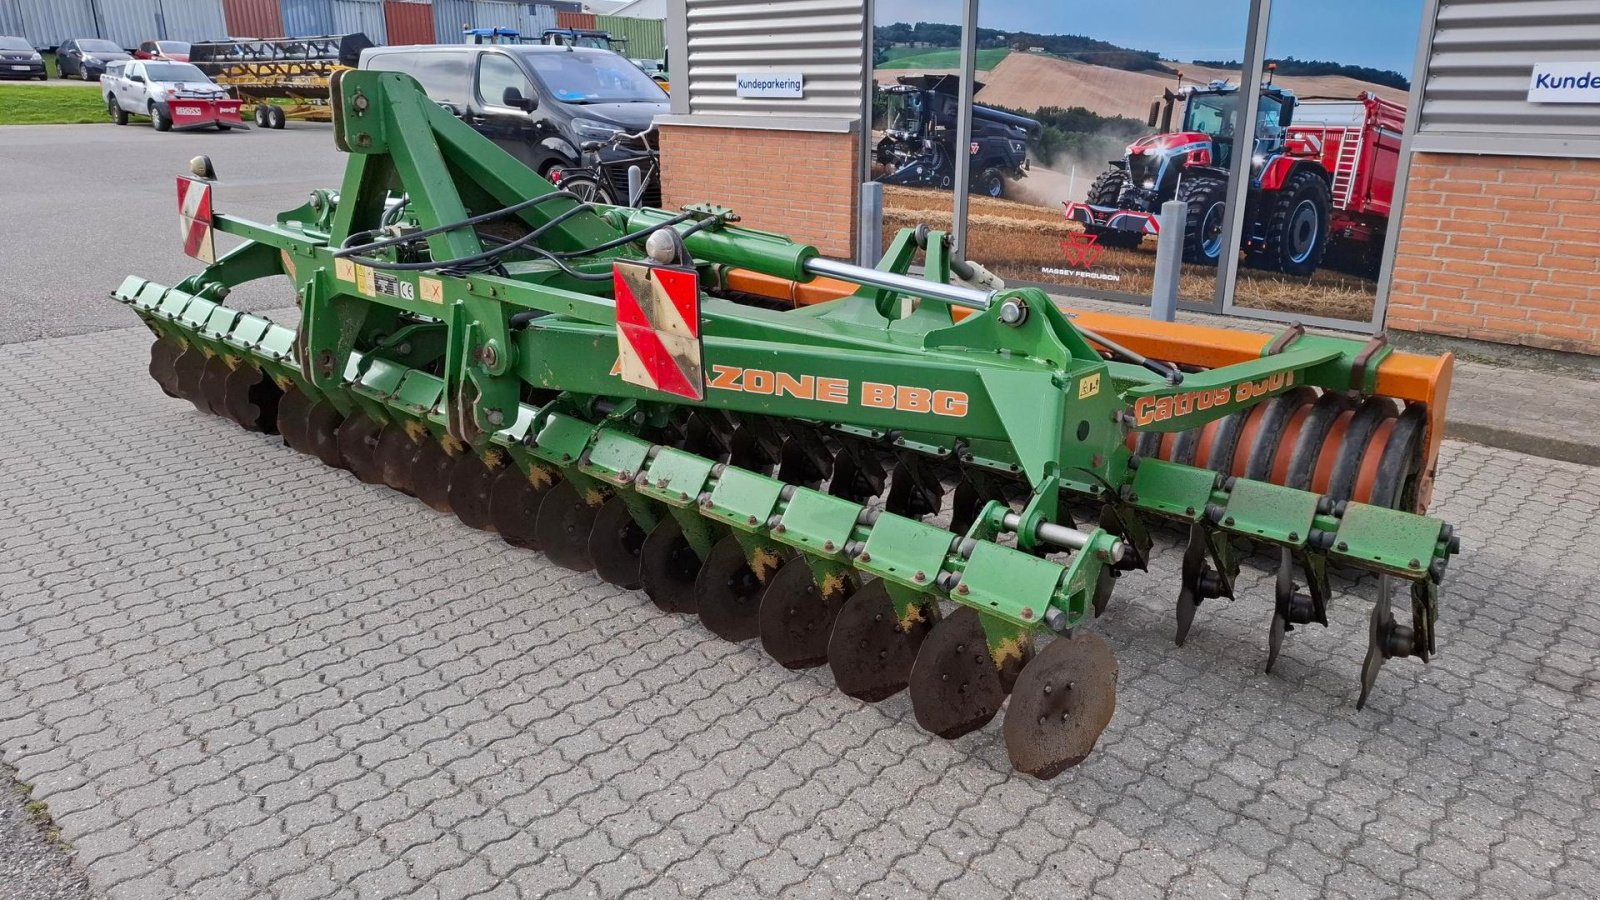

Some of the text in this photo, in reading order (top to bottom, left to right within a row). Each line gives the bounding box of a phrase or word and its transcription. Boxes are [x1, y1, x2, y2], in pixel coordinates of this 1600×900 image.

[738, 78, 801, 92] Kundeparkering
[1536, 72, 1600, 89] Kunde
[1042, 267, 1119, 281] MASSEY FERGUSON
[401, 283, 413, 298] CE
[609, 356, 970, 418] ZONE BBG
[1134, 387, 1231, 426] Catros
